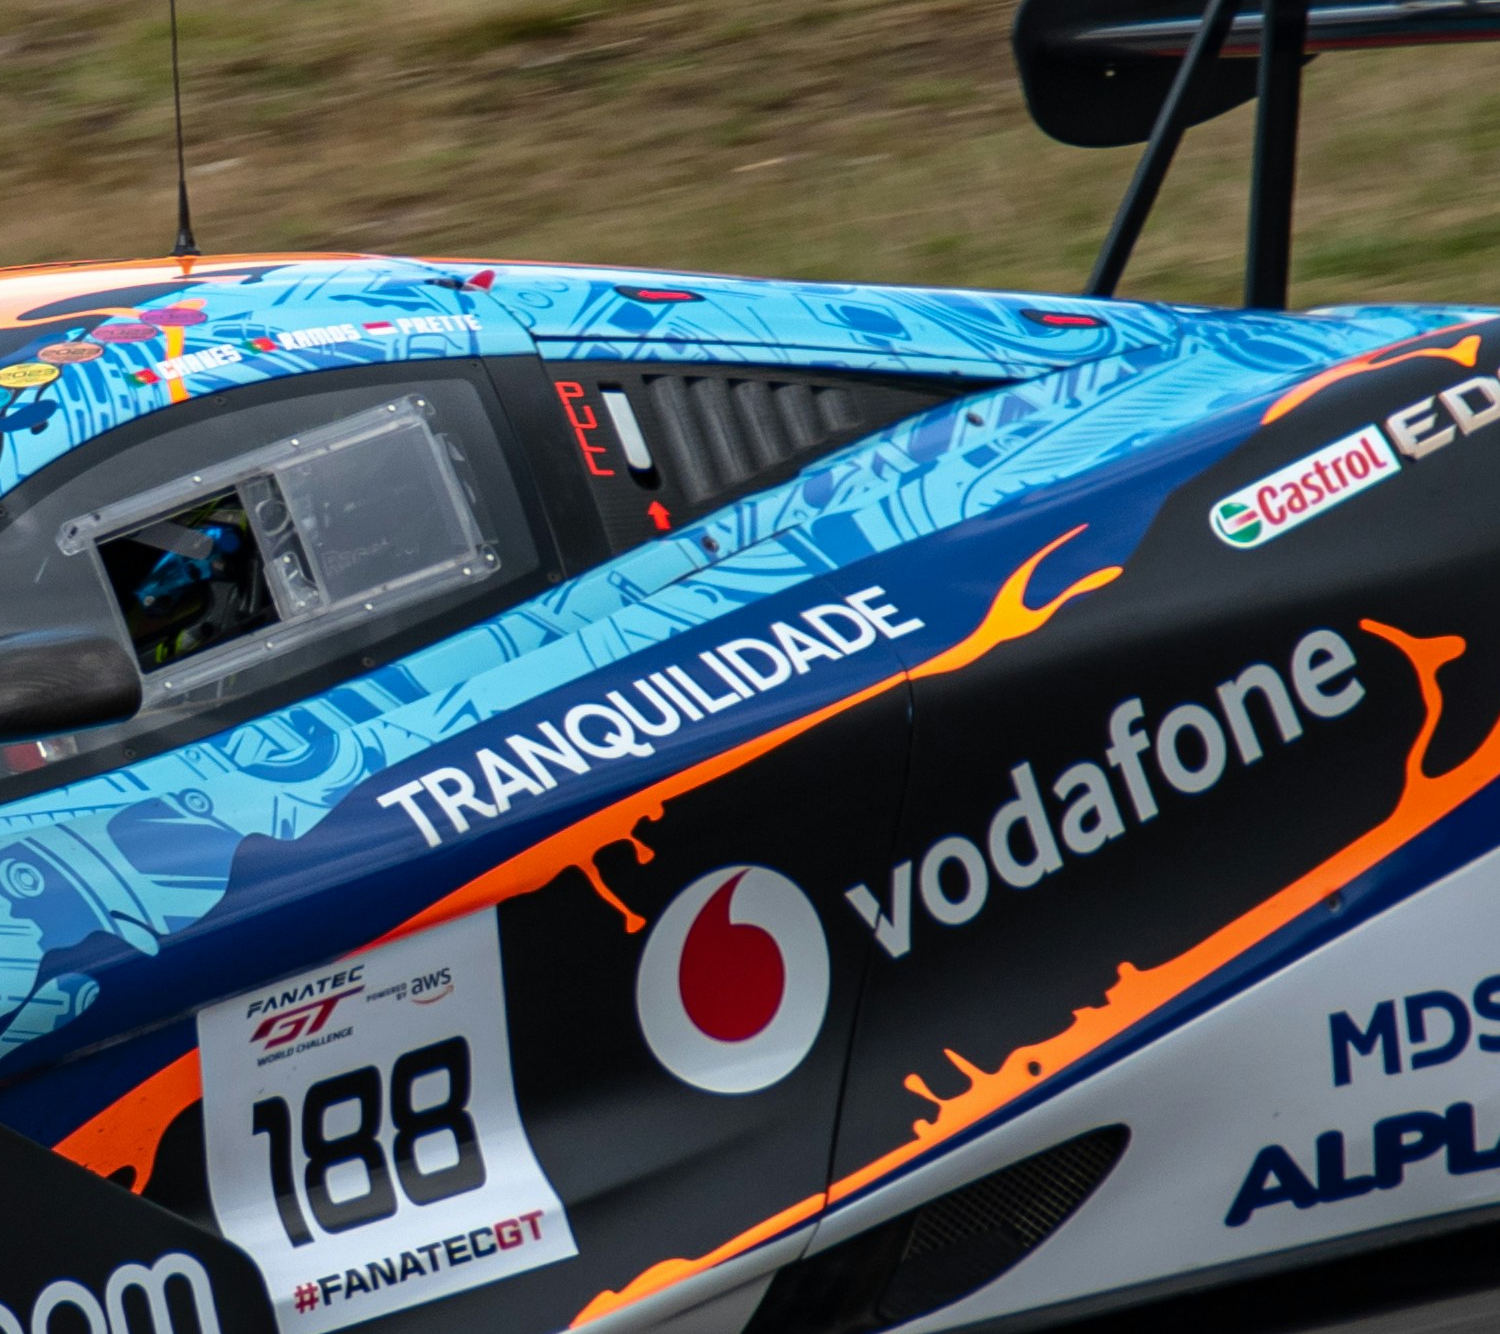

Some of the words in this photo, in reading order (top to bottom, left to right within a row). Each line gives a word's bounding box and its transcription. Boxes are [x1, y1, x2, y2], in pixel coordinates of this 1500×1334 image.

[277, 323, 361, 352] RAMOS
[397, 314, 483, 335] PRETTE
[555, 381, 615, 476] PULL
[1255, 436, 1388, 527] Castrol
[376, 585, 924, 848] TRANQUILIDADE
[845, 628, 1367, 958] vodafone
[247, 965, 365, 1019] FANATEC
[250, 985, 365, 1051] GT
[412, 968, 451, 995] aws
[257, 1047, 294, 1067] WORLD
[296, 1026, 353, 1053] CHALLENGE
[252, 1035, 487, 1249] 188
[294, 1210, 544, 1313] #FANATECGT
